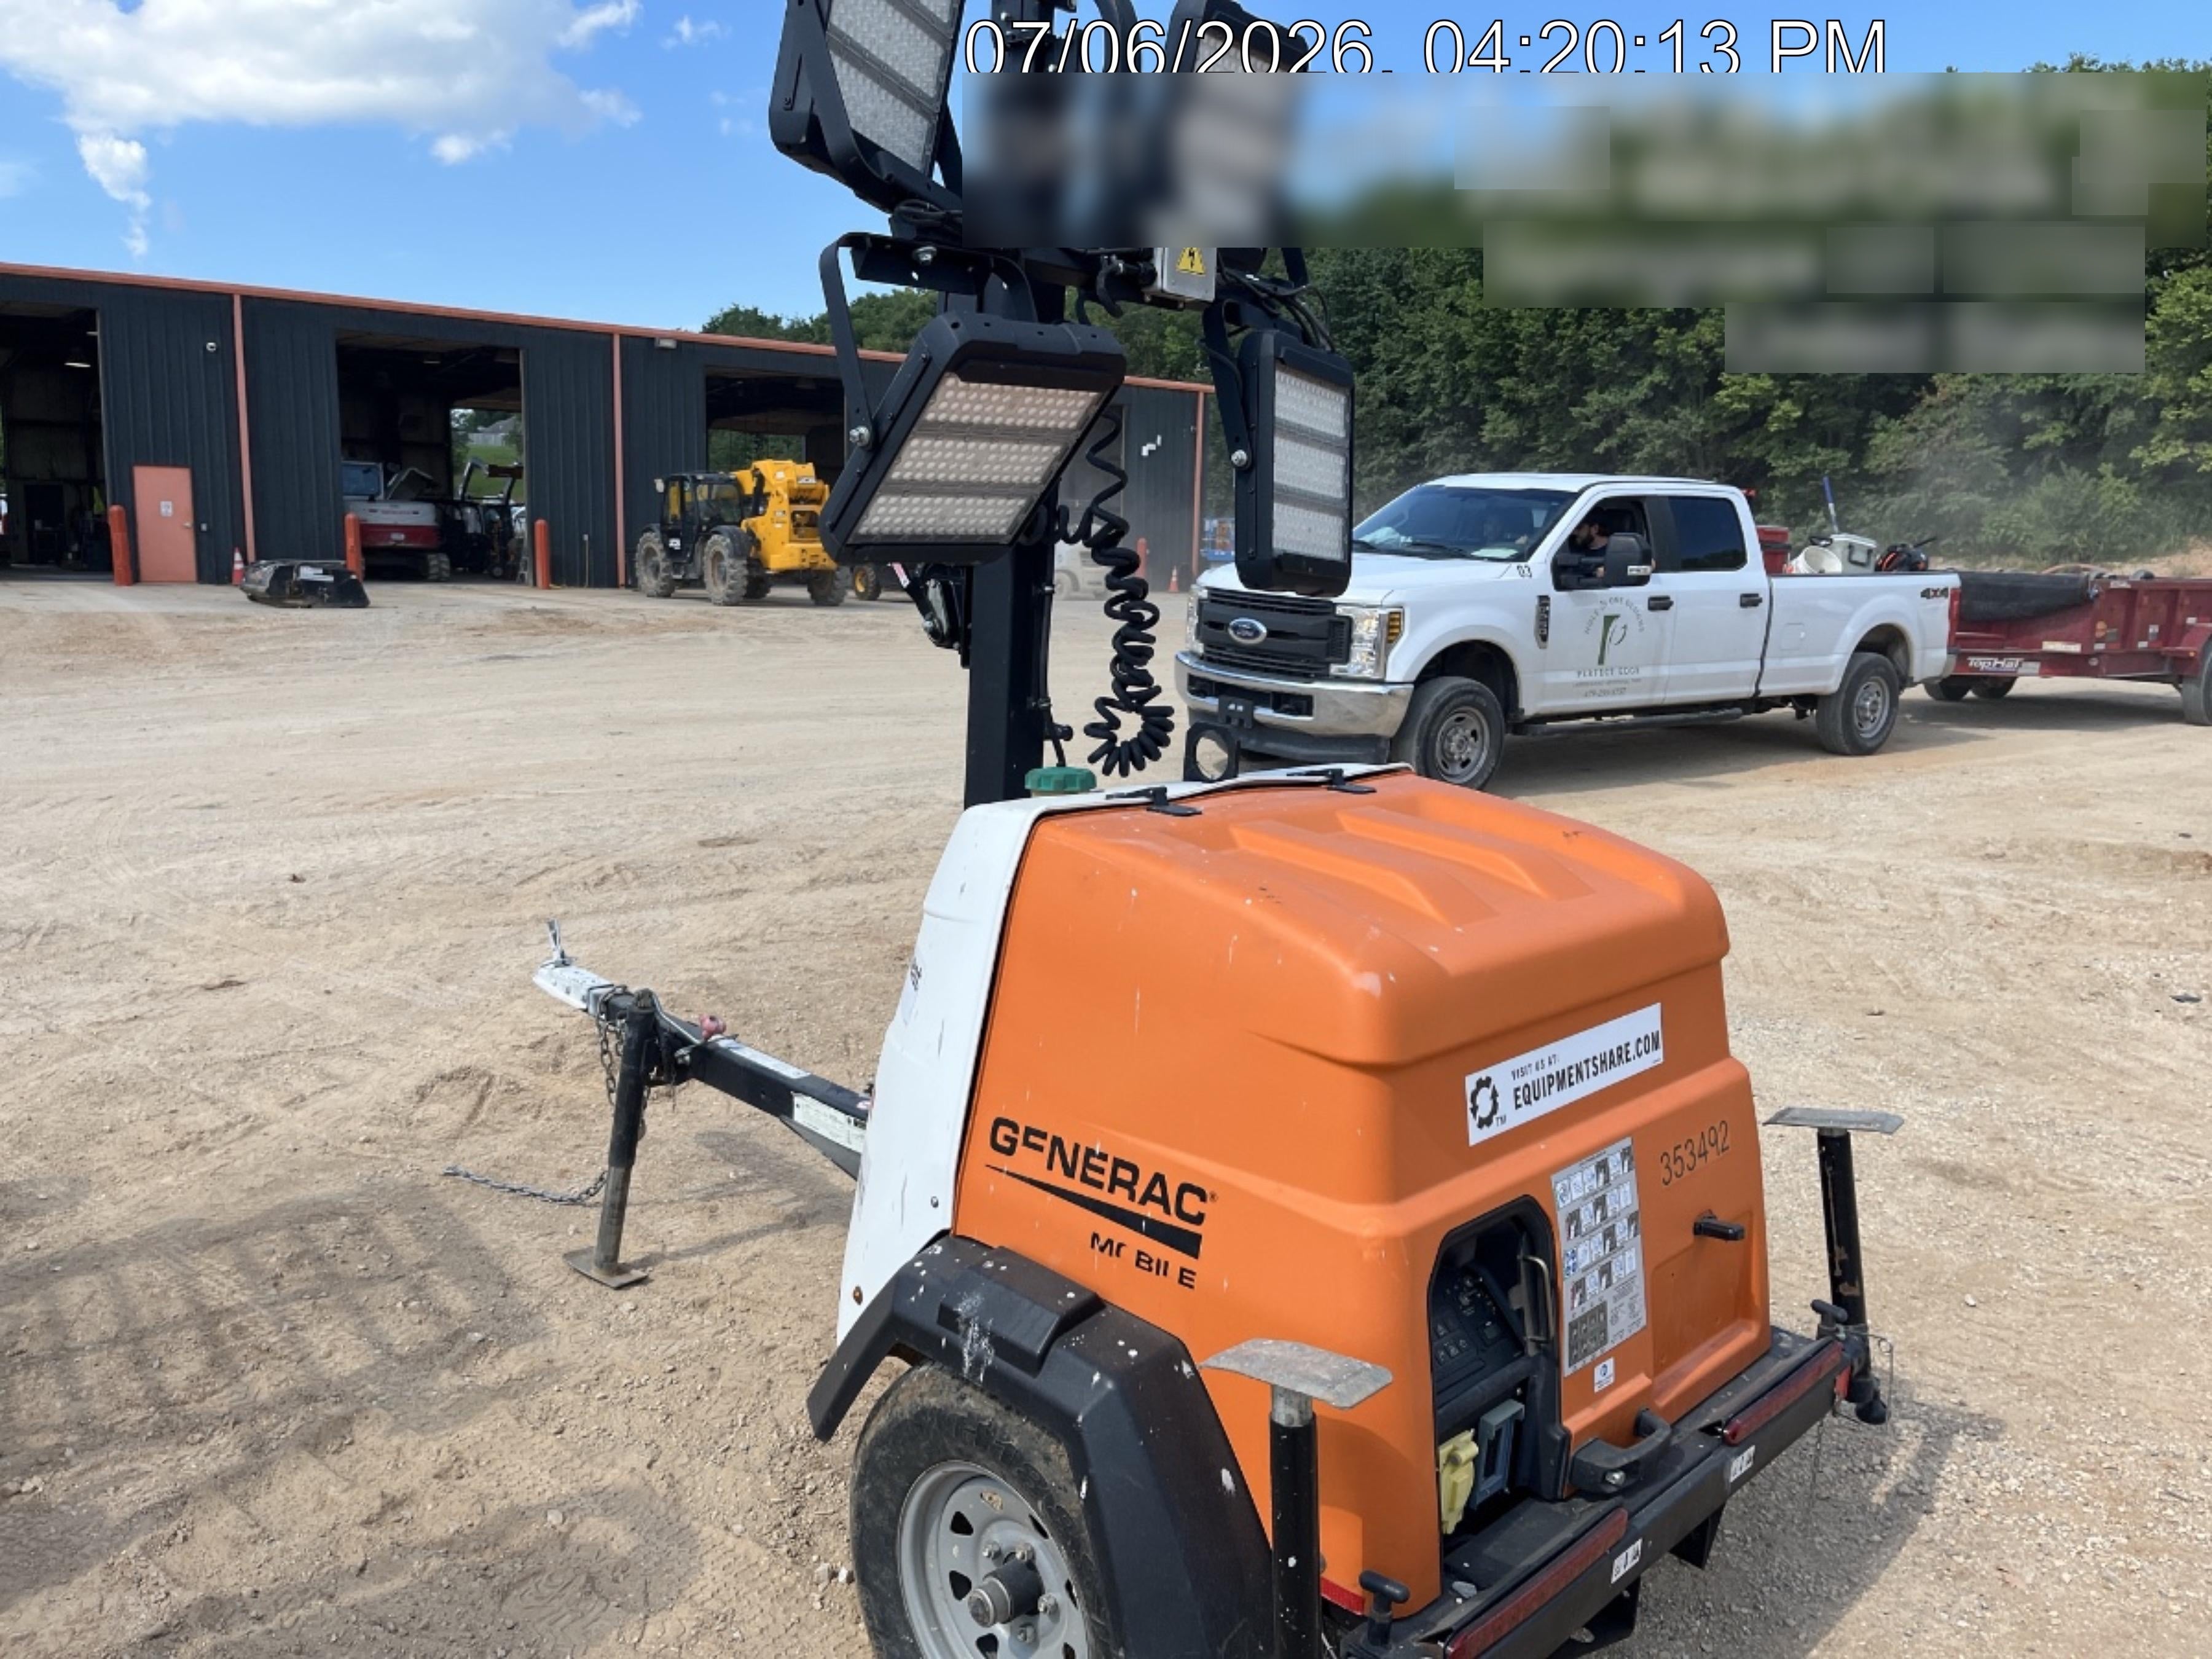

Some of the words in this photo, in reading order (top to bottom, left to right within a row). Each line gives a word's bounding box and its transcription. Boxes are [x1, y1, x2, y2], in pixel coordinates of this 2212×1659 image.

[1511, 1063, 1532, 1080] VISIT
[1535, 1058, 1545, 1072] US
[1513, 1030, 1660, 1110] EQUIPMENTSHARE.COM
[1660, 1120, 1730, 1186] 353492
